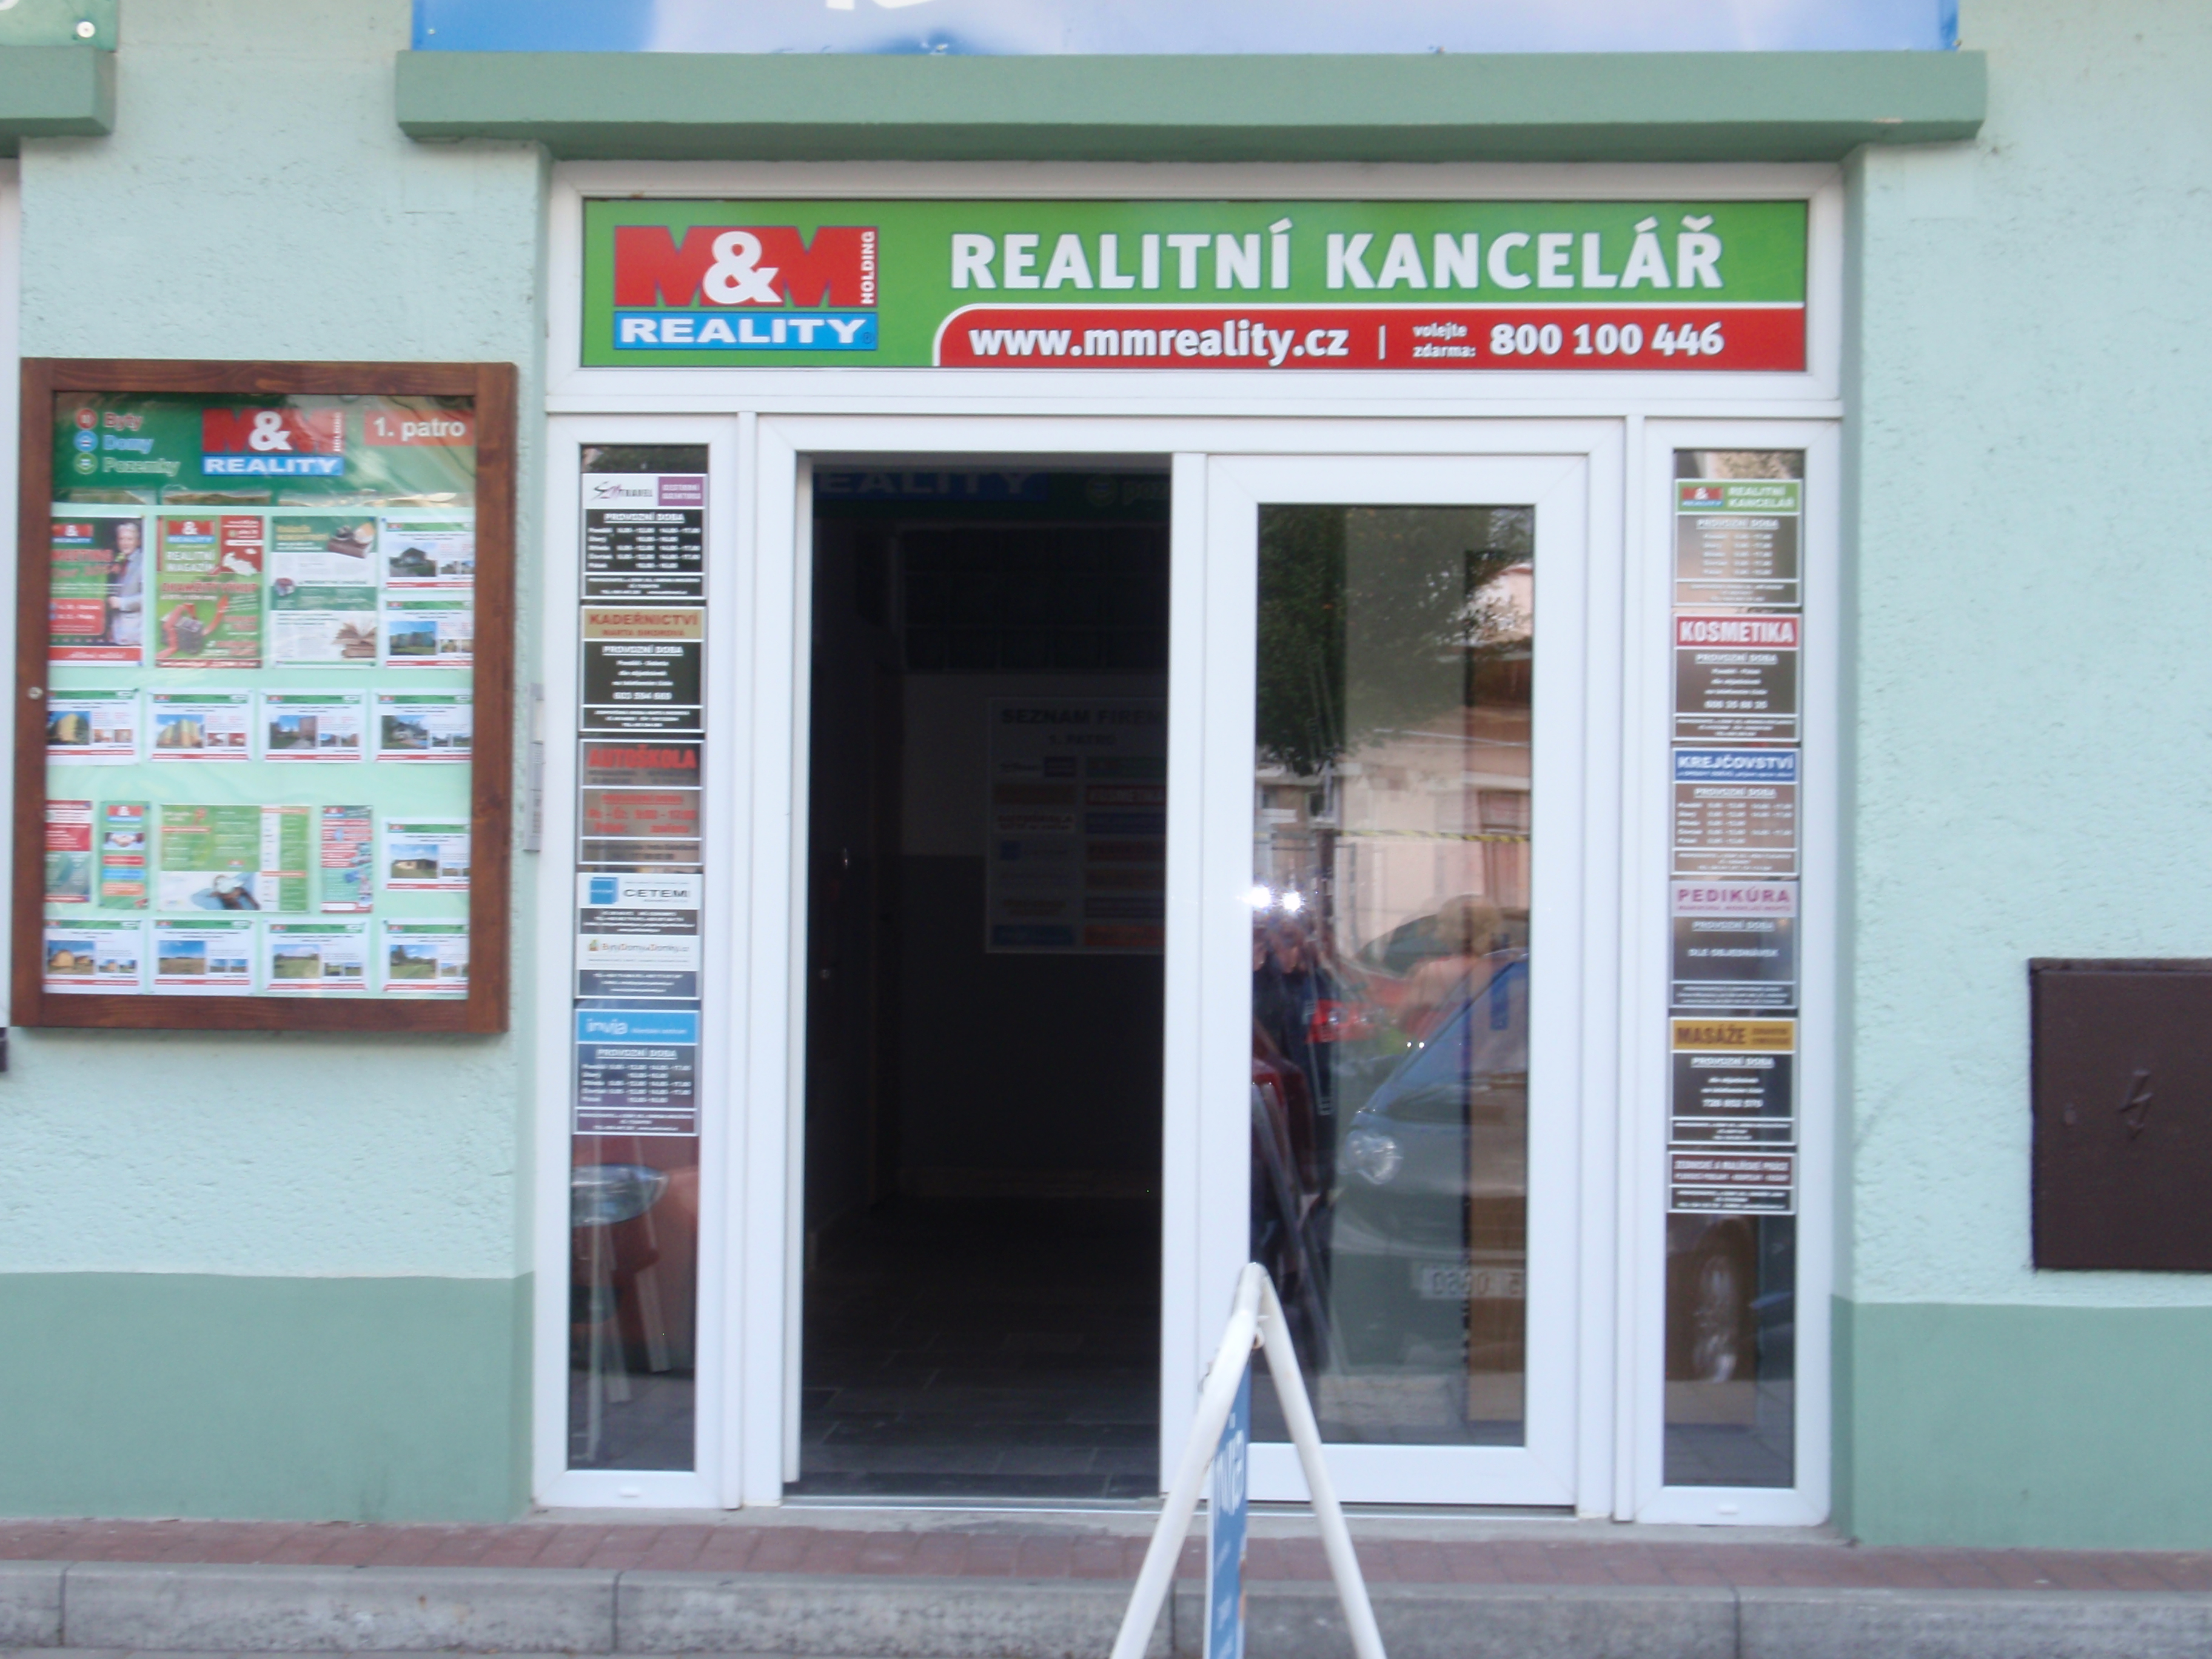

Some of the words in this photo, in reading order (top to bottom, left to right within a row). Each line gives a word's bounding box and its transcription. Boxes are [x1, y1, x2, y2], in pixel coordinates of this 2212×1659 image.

[951, 217, 1293, 289] REALITNÍ
[1327, 215, 1724, 289] KANCELÁŘ
[614, 226, 877, 307] M&M
[860, 230, 875, 304] HOLDING
[621, 318, 866, 350] REALITY
[968, 318, 1349, 367] www.mmreality.cz
[1413, 322, 1467, 340] volejte
[1490, 323, 1562, 356] 800
[1573, 324, 1643, 356] 100
[1652, 323, 1725, 357] 446
[1413, 344, 1476, 358] zdarma:
[374, 417, 394, 437] 1.
[401, 417, 466, 441] patro
[204, 457, 338, 472] REALITY
[589, 612, 698, 625] KADEŘNICTVÍ
[1680, 620, 1794, 642] KOSMETIKA
[588, 743, 697, 768] AUTOŠKOLA
[1678, 886, 1789, 902] PEDIKÚRA
[1677, 1024, 1745, 1044] MASÁŽE
